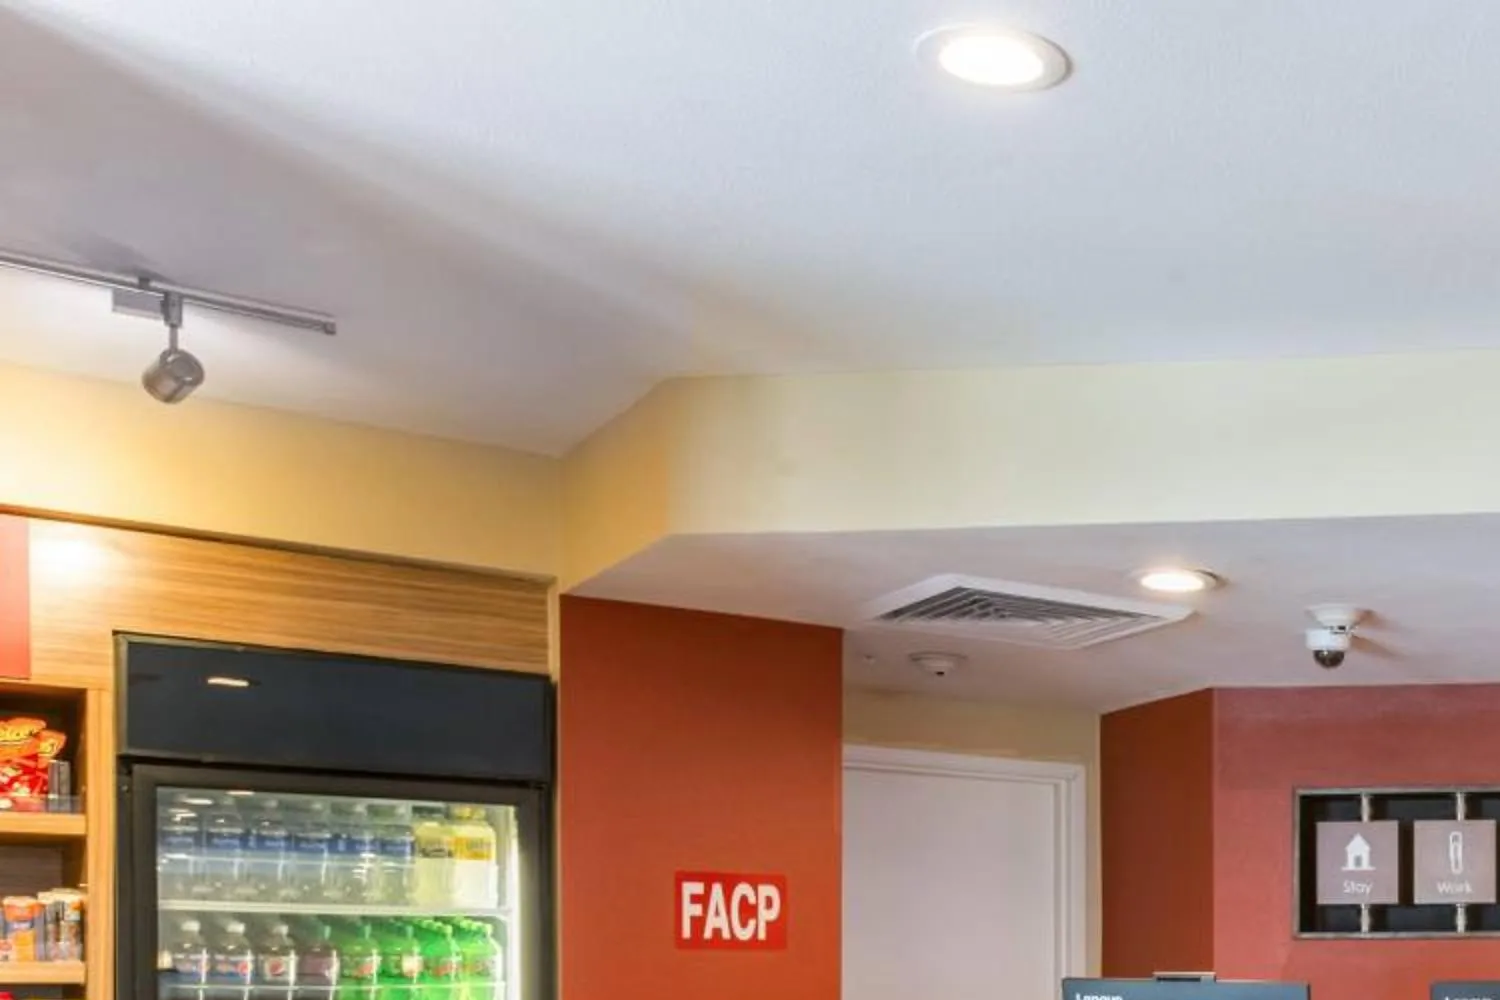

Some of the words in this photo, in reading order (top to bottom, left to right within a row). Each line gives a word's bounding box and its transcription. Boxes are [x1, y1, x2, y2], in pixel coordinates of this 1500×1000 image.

[1343, 880, 1373, 894] Stay
[1437, 880, 1473, 894] Work
[681, 881, 781, 941] FACP
